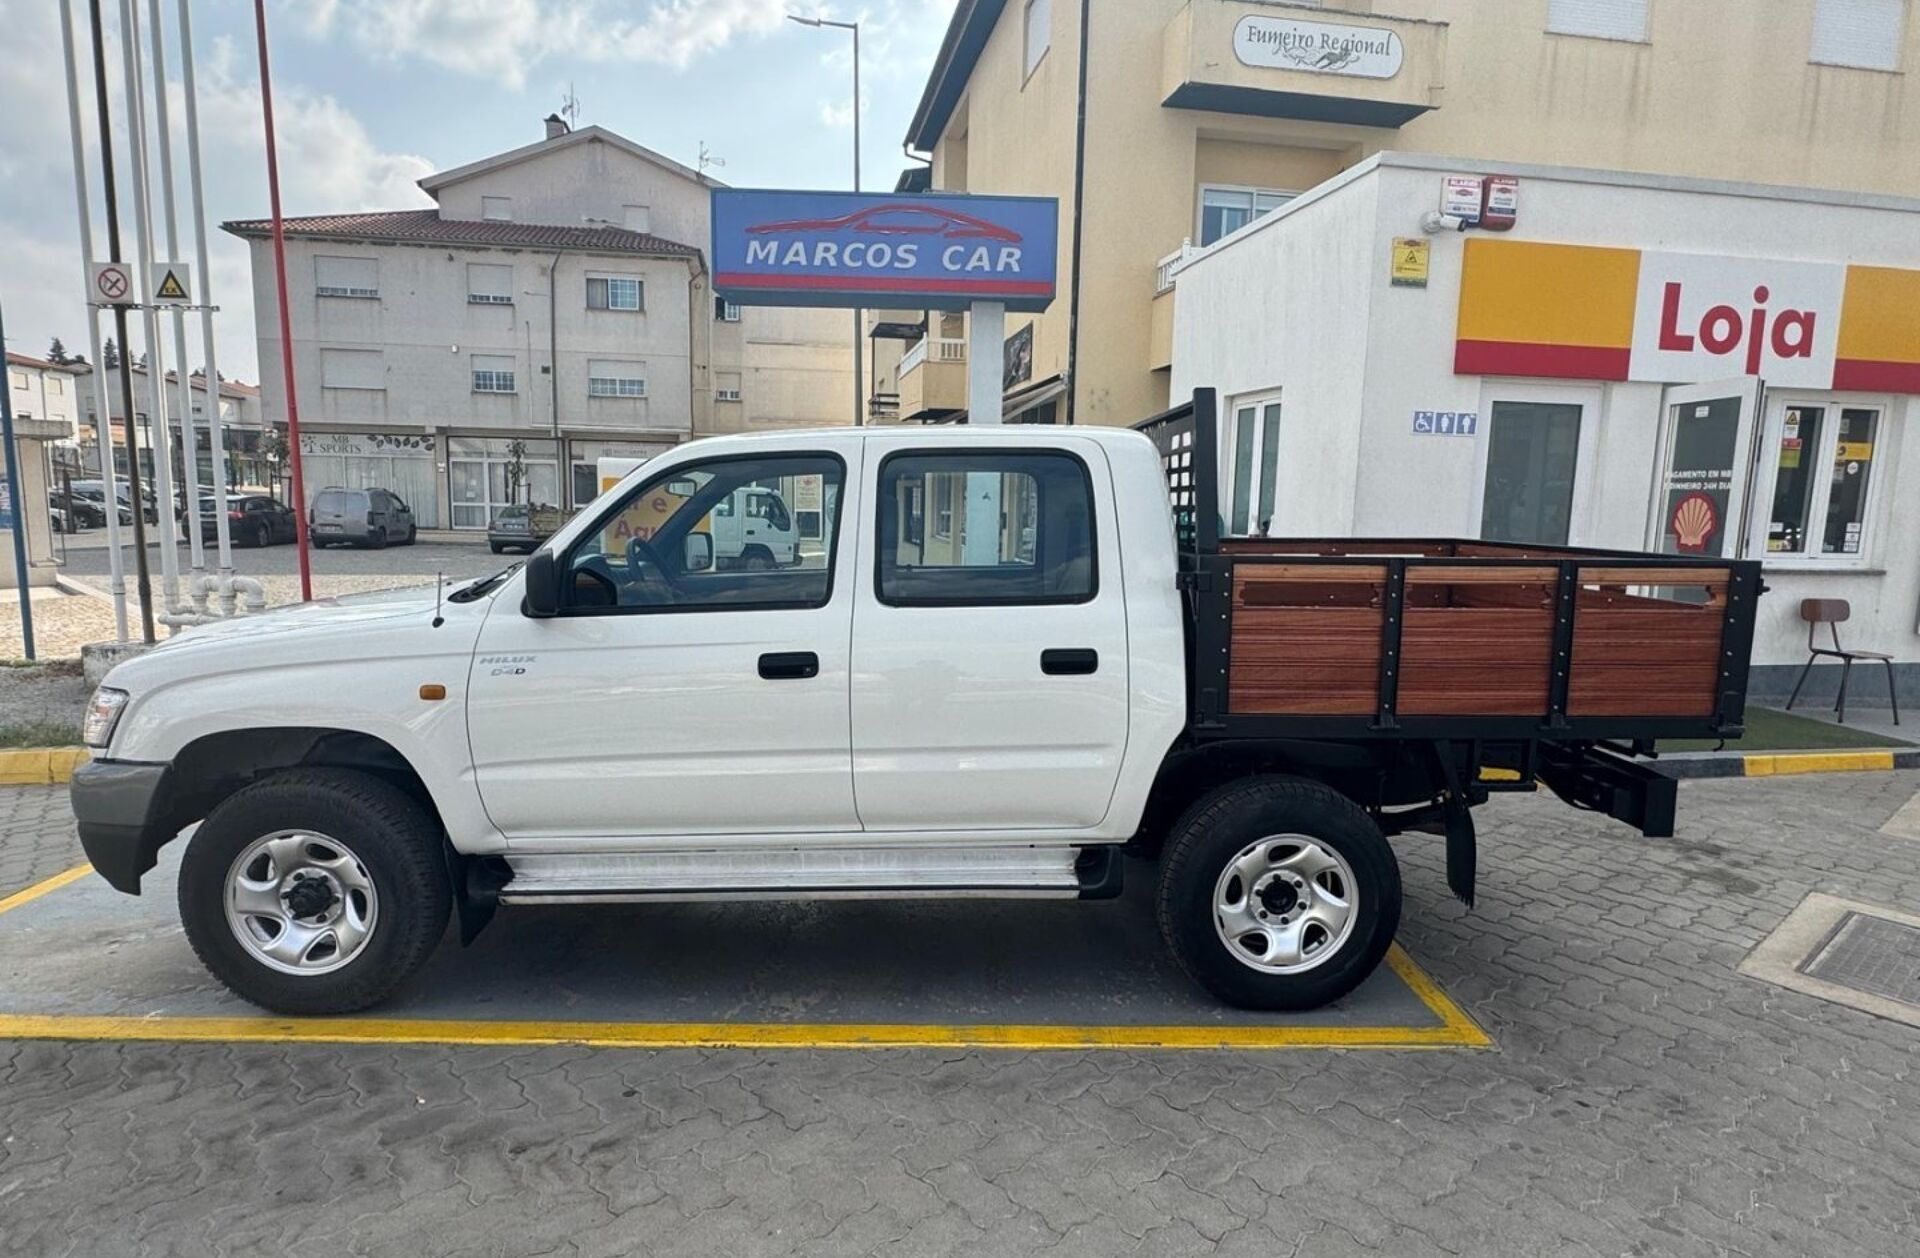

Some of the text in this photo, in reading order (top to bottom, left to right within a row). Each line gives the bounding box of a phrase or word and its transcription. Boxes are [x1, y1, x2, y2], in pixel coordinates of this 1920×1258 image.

[1247, 25, 1392, 57] Fumeiro Regional
[745, 240, 1022, 273] MARCOS CAR
[1658, 281, 1816, 375] Loja
[320, 443, 361, 454] SPORTS
[480, 656, 537, 664] HILUX
